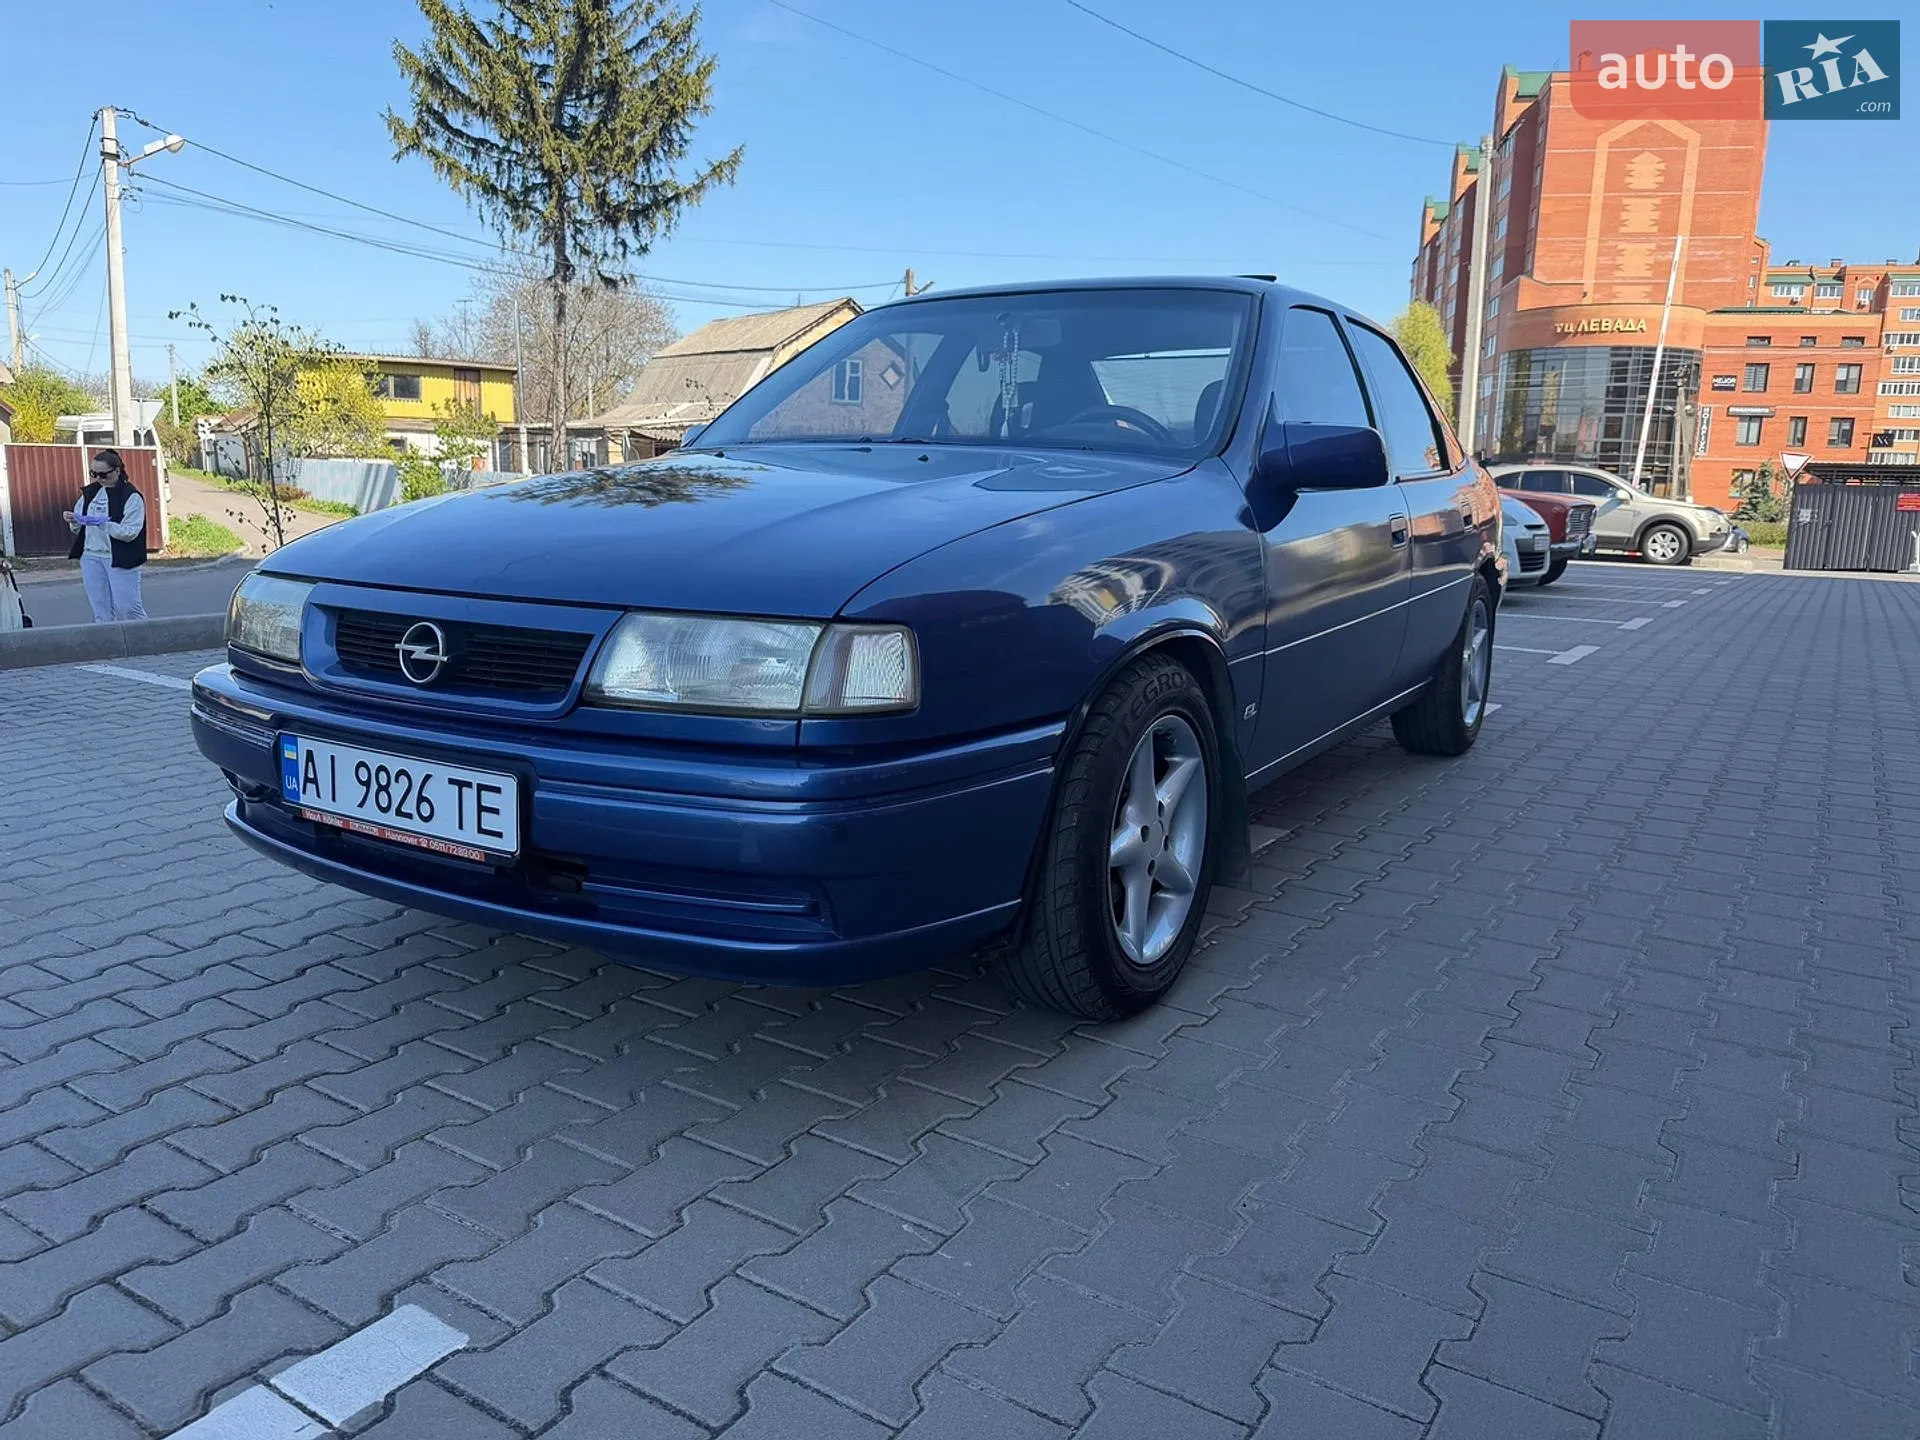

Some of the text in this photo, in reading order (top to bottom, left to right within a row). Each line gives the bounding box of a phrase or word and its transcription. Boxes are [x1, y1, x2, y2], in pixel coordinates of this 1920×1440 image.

[1577, 317, 1648, 333] ЛЕВАДА
[285, 748, 504, 839] UA AI 9826 TE
